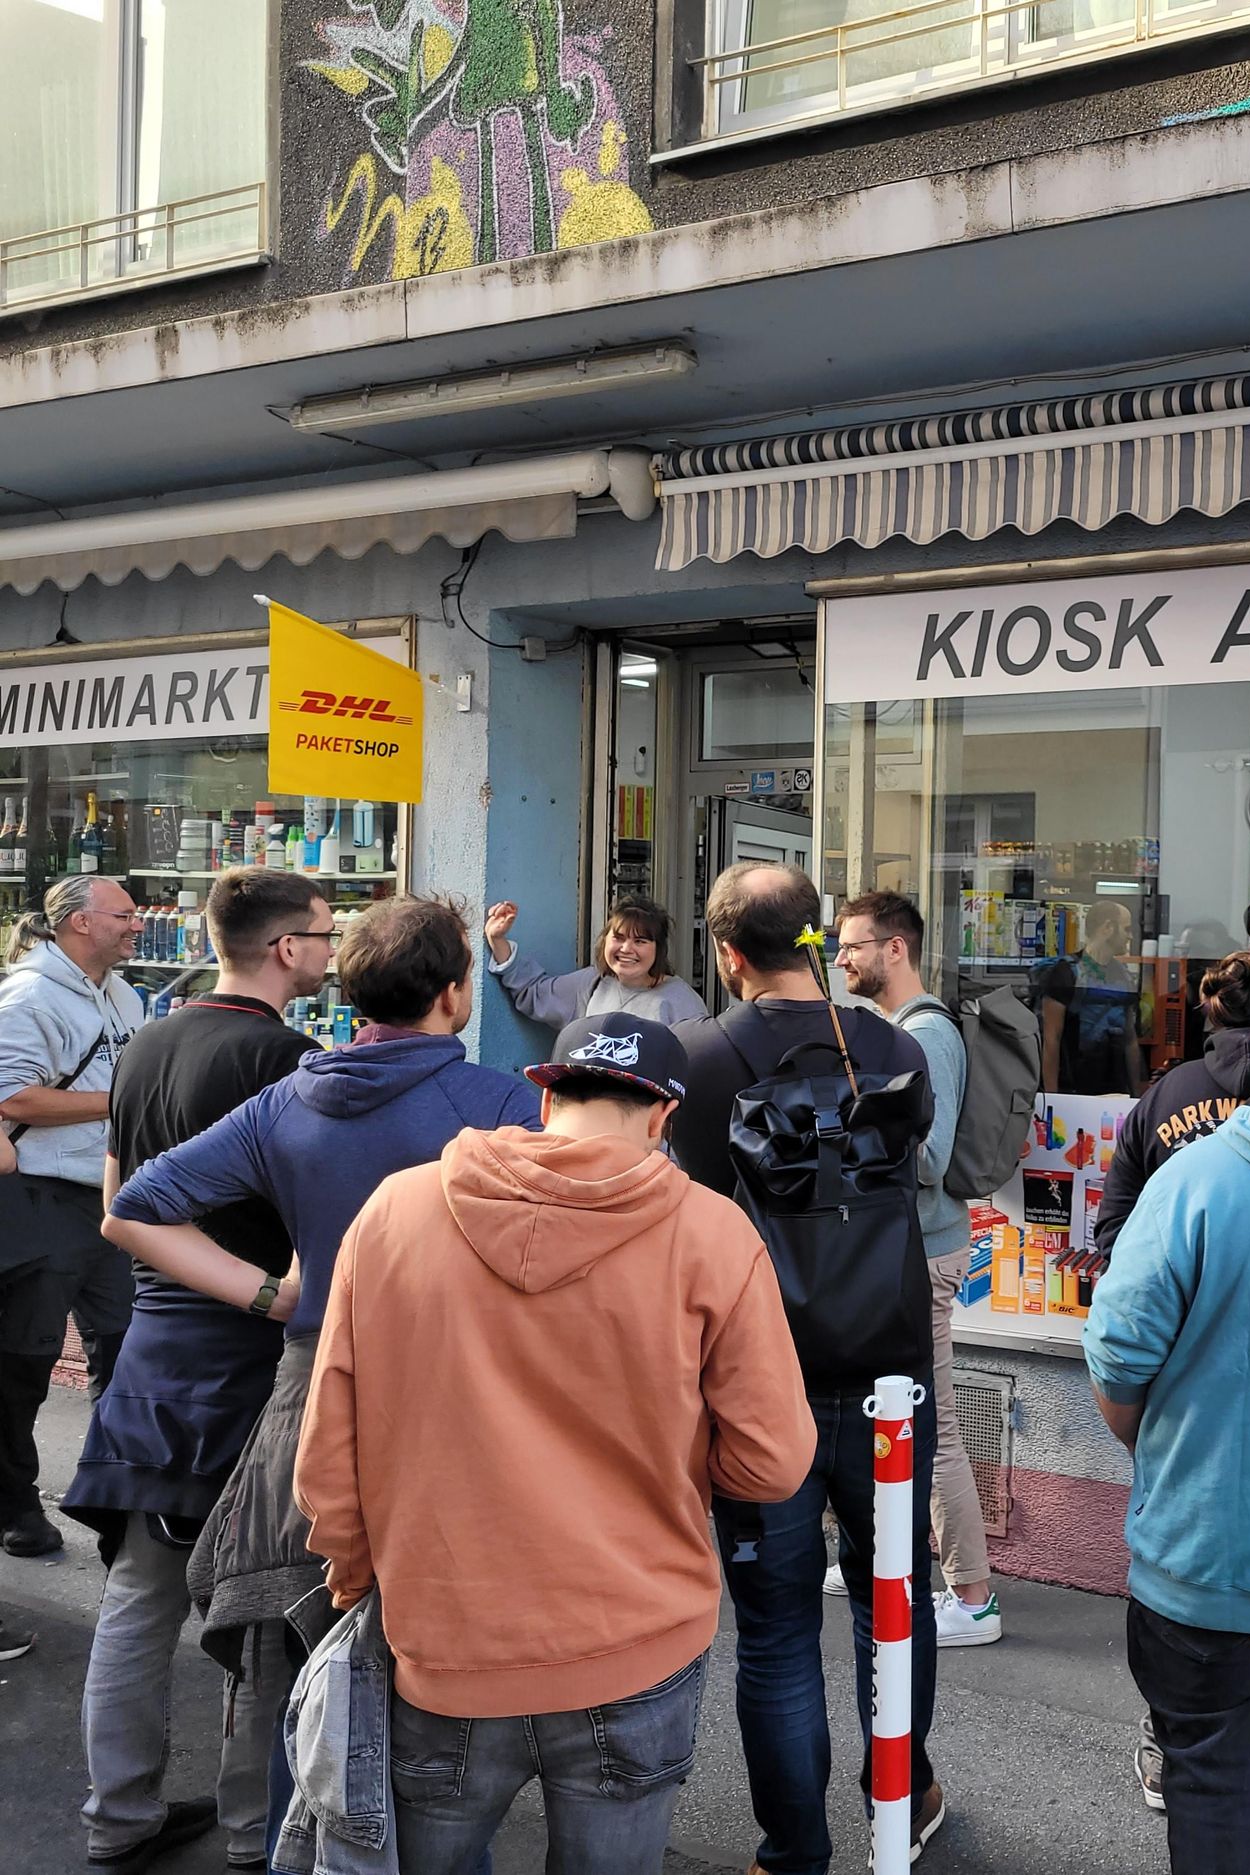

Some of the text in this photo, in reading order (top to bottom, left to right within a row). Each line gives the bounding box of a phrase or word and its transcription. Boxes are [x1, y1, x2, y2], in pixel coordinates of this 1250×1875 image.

[917, 594, 1173, 681] KIOSK
[298, 690, 396, 723] DHL
[295, 733, 400, 758] PAKETSHOP
[1156, 1098, 1245, 1148] PARKW
